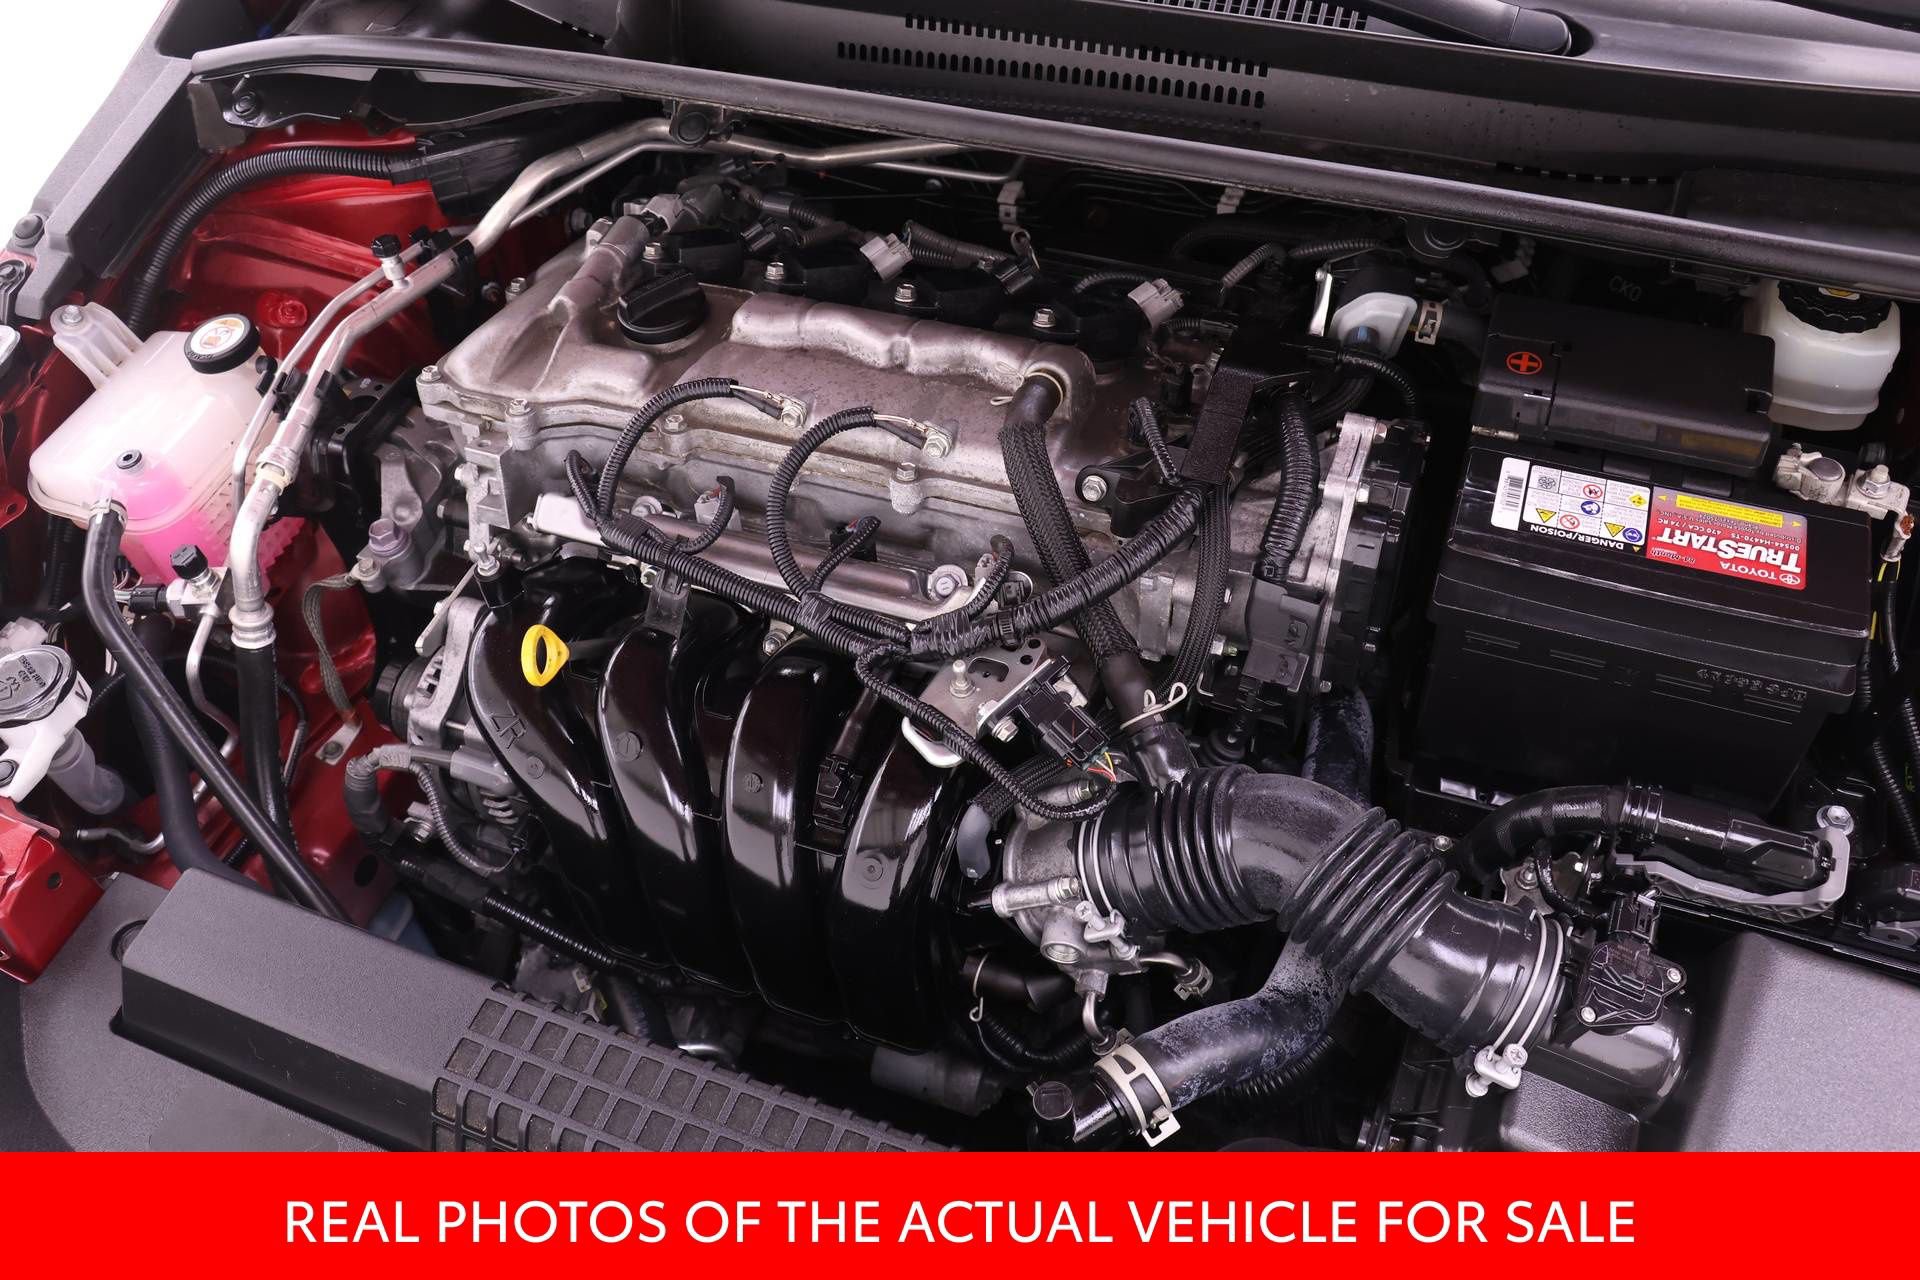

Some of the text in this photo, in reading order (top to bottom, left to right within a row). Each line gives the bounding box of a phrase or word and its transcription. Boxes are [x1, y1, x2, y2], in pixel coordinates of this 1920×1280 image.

[1530, 524, 1624, 550] DANGER/POISON
[1688, 524, 1705, 532] CCA
[1720, 561, 1777, 580] TOYOTA
